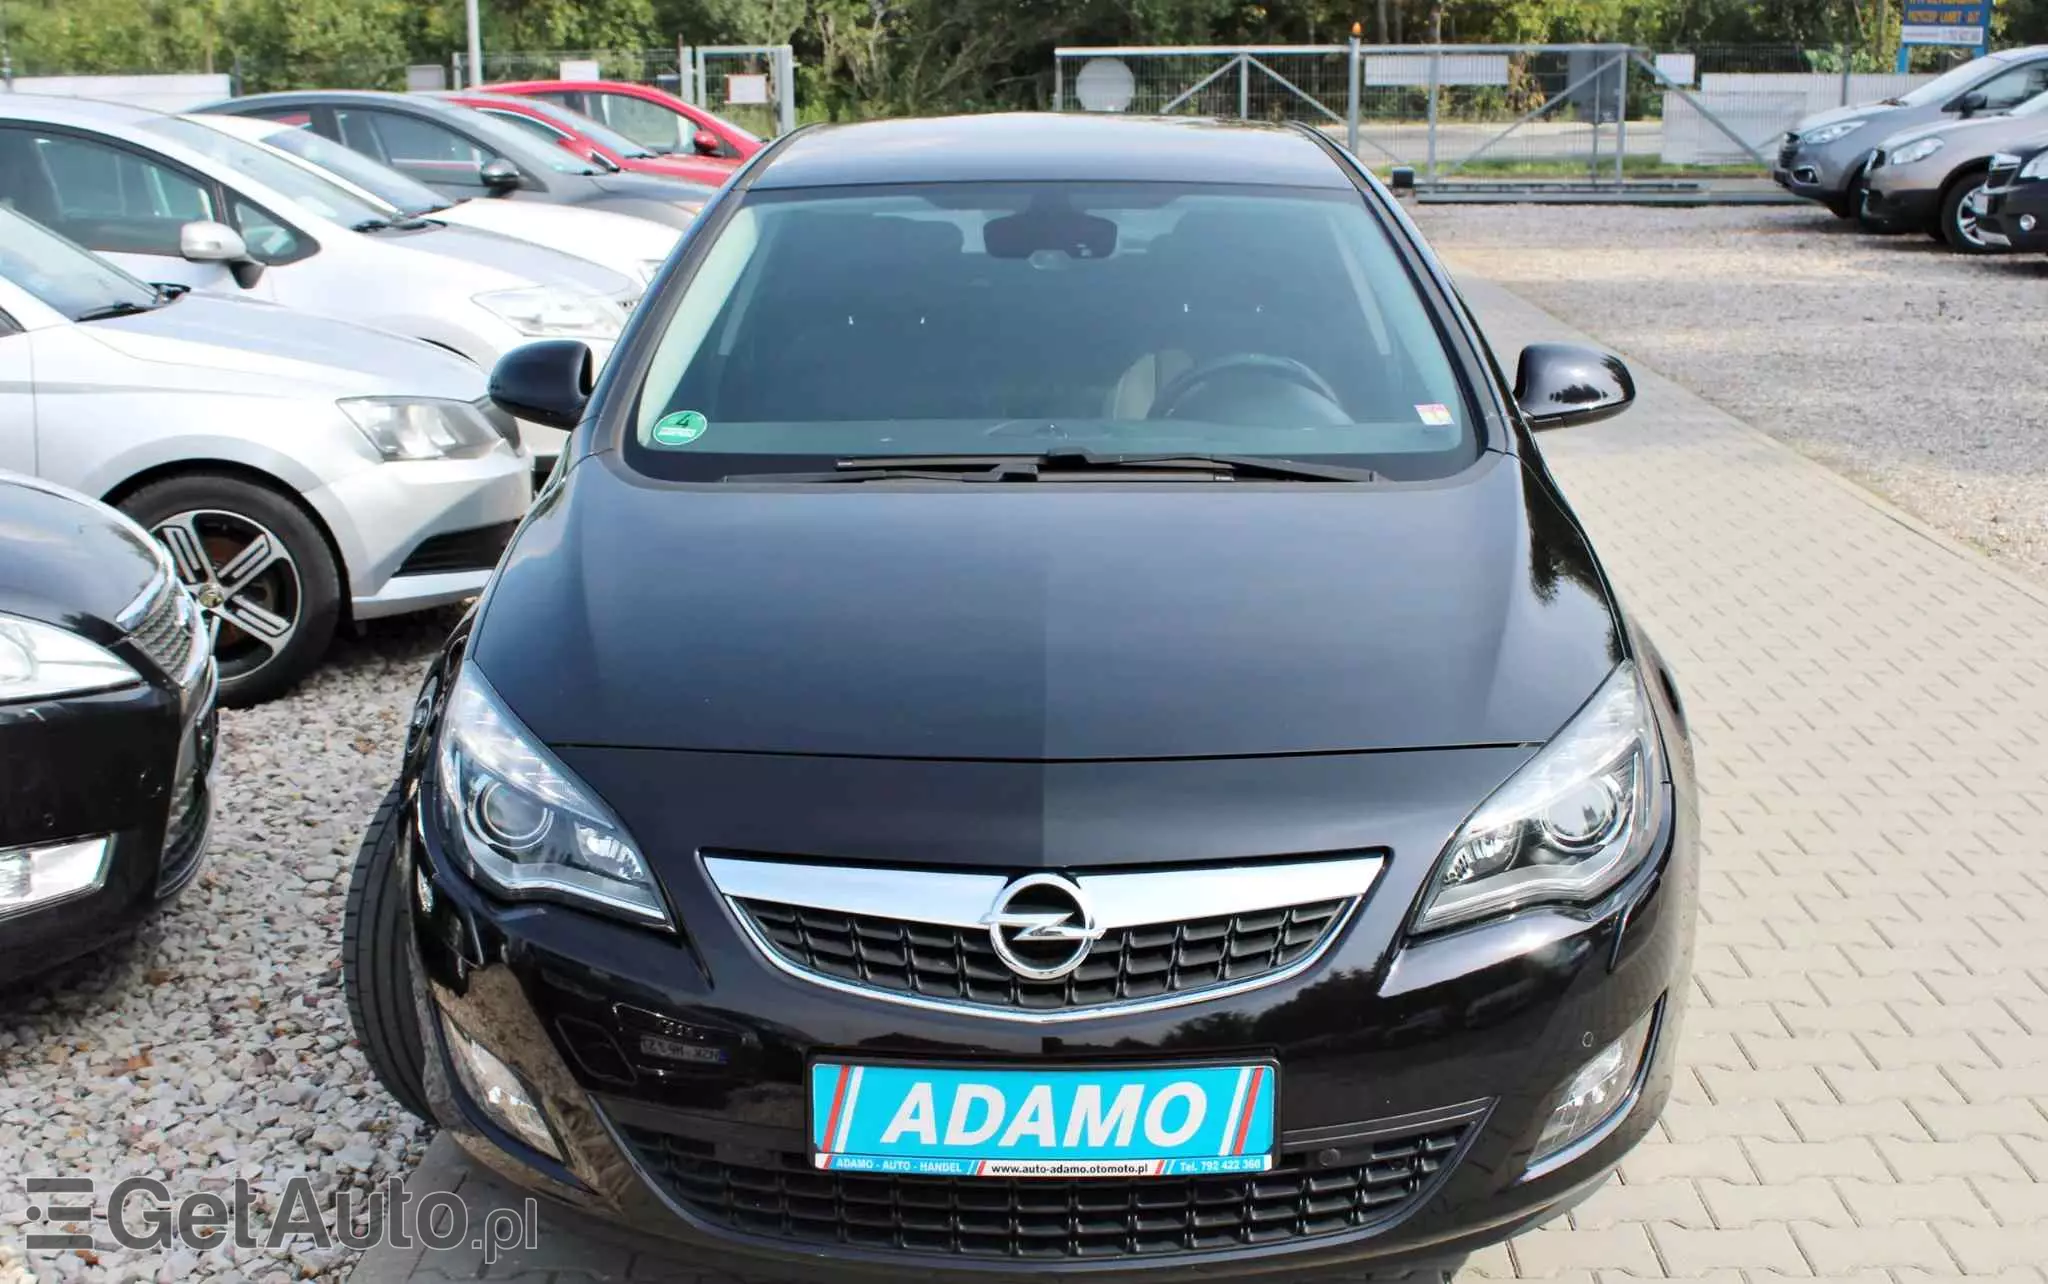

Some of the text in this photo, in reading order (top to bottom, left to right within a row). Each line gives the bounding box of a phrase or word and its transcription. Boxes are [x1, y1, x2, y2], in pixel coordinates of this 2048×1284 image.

[675, 414, 691, 428] 4
[880, 1081, 1207, 1148] ADAMO
[836, 1158, 874, 1169] ADAMO
[882, 1159, 911, 1171] AUTO
[919, 1160, 962, 1173] HANDEL
[991, 1163, 1148, 1175] www.auto-adamo.otomoto.pl
[1200, 1161, 1220, 1171] 792
[1222, 1160, 1240, 1170] 422
